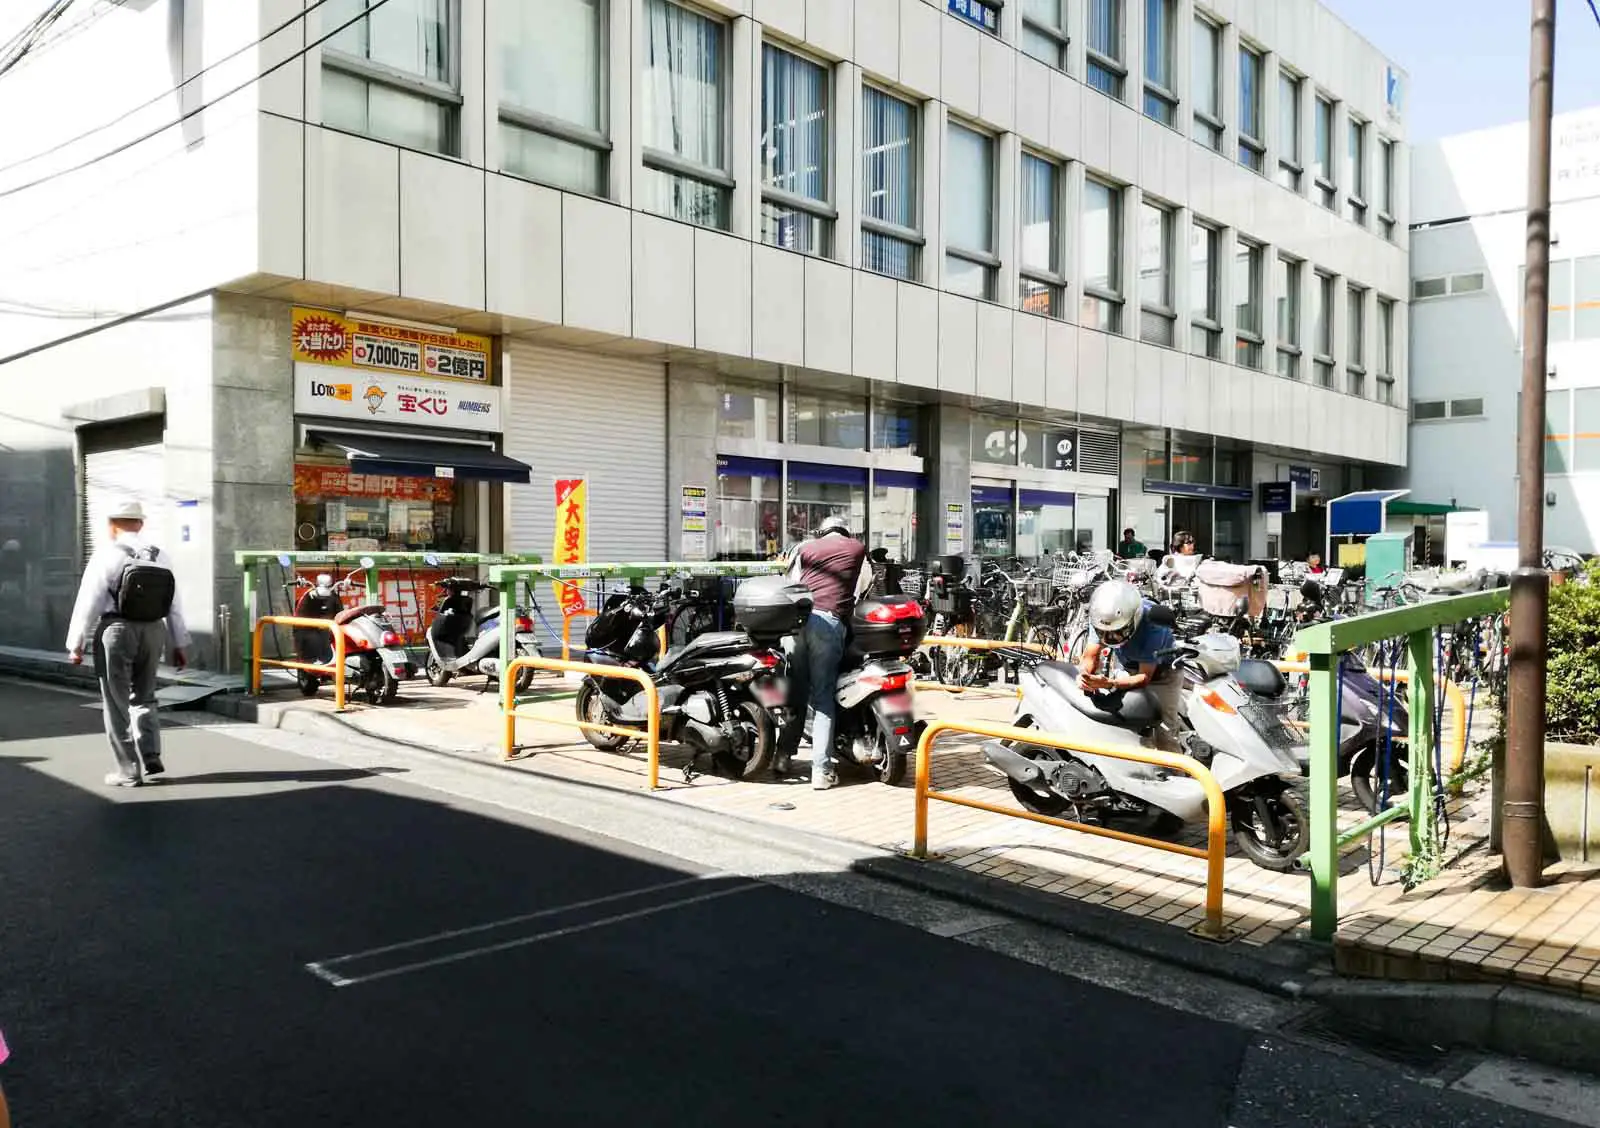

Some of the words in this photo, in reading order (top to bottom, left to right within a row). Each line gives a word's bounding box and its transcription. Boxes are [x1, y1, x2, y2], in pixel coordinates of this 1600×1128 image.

[366, 343, 419, 370] 7,000万円
[438, 355, 485, 378] 2億円
[311, 381, 336, 397] LOTO
[397, 394, 448, 416] 宝くじ
[457, 400, 492, 413] NUMBERS
